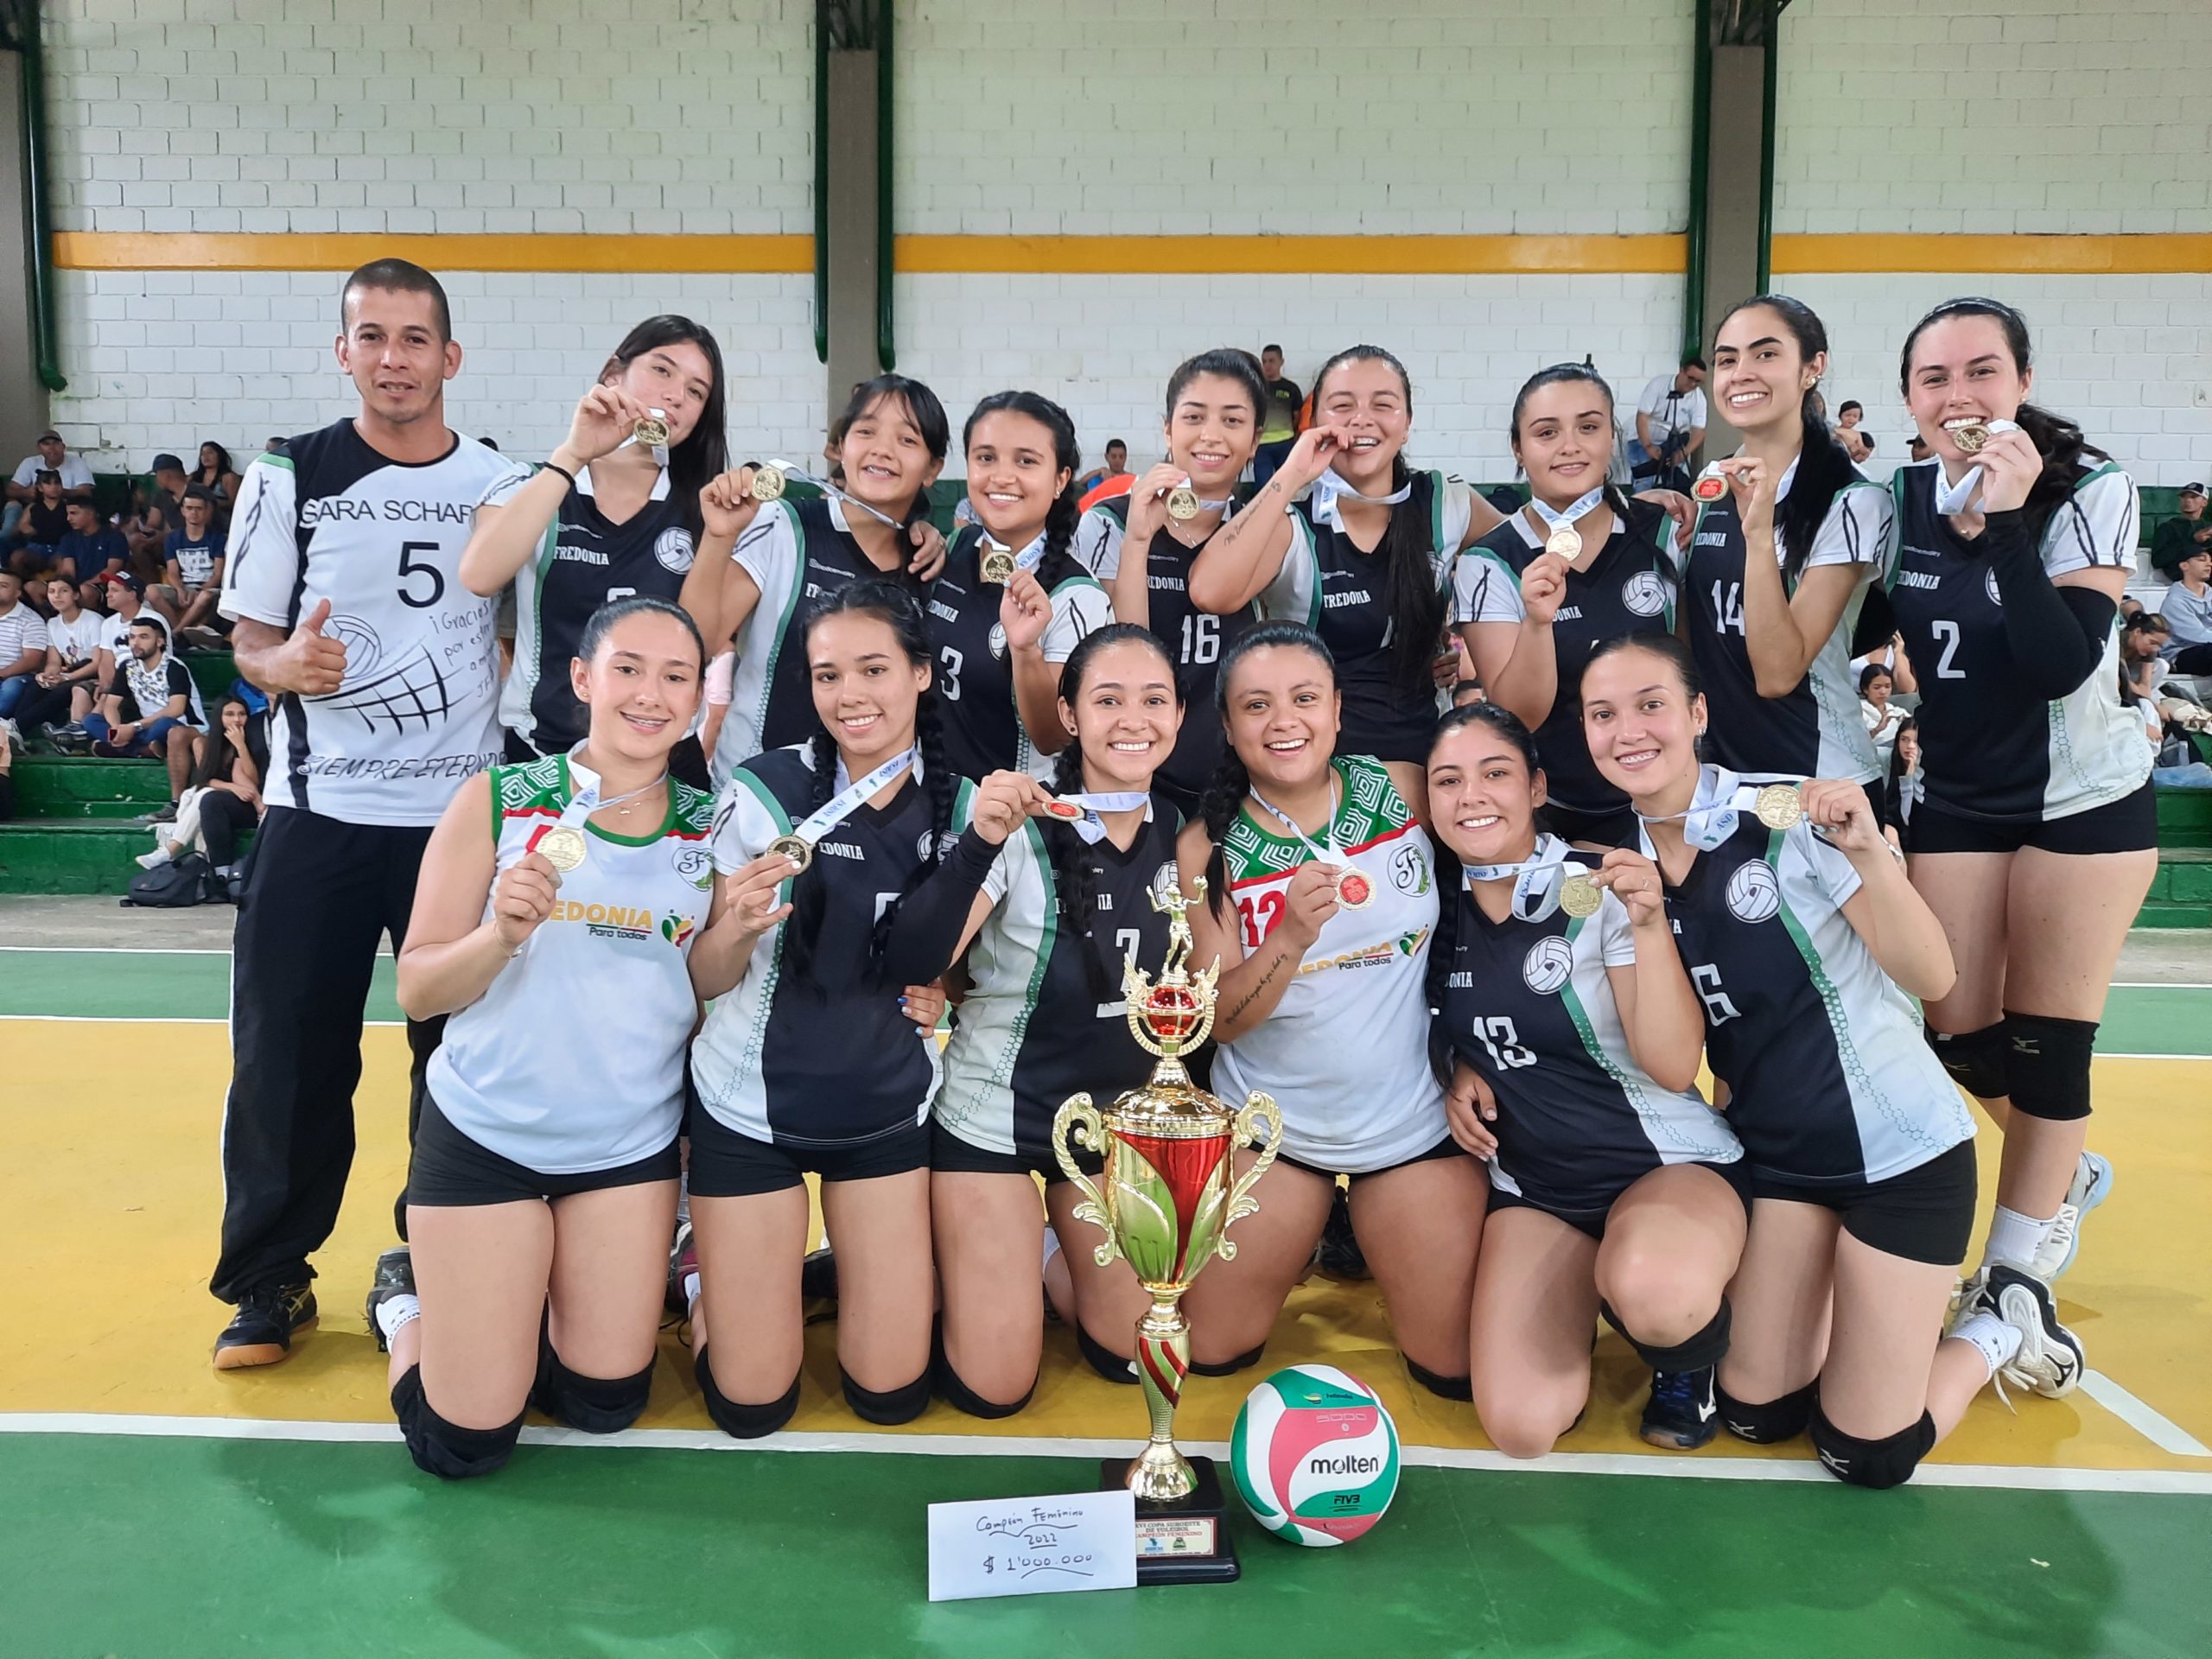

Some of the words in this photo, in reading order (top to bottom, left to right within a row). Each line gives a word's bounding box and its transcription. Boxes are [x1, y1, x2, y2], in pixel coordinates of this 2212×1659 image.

[302, 499, 376, 524] SARA
[553, 544, 610, 565] FREDONIA
[397, 541, 444, 608] 5
[1711, 579, 1745, 636] 14
[1180, 613, 1219, 664] 16
[1932, 620, 1966, 678] 2
[941, 645, 963, 701] 3
[296, 755, 422, 779] SIEMPRE
[547, 900, 652, 928] EDONIA
[1237, 890, 1286, 948] 12
[588, 926, 614, 937] Para
[617, 928, 647, 941] todos
[1338, 961, 1361, 970] Para
[1364, 956, 1391, 967] todos
[1691, 963, 1742, 1027] 6
[1473, 1016, 1538, 1071] 13
[1311, 1455, 1379, 1474] molten
[1024, 1532, 1058, 1545] 2022
[982, 1554, 995, 1574] $
